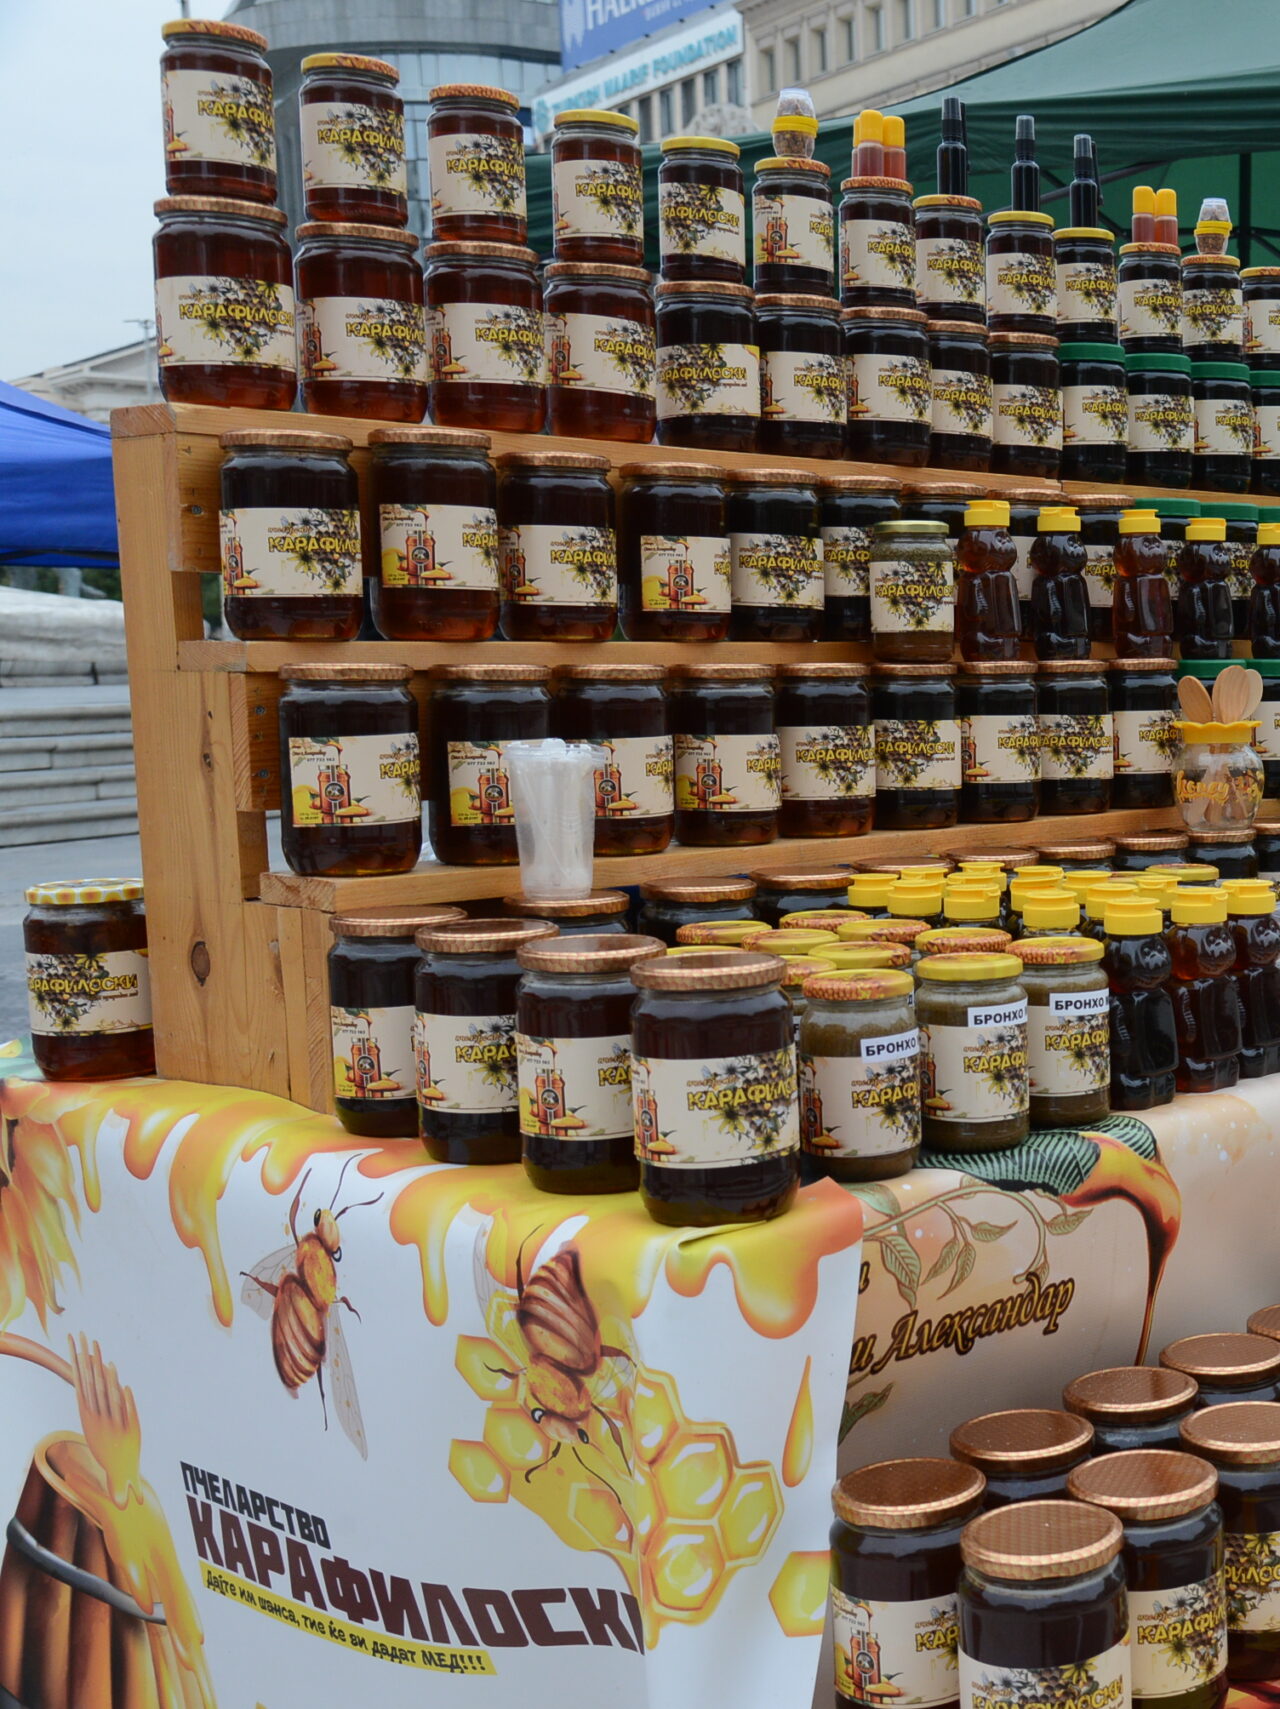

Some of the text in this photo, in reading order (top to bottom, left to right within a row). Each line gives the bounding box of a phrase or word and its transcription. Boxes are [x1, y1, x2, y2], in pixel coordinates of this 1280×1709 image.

[974, 1009, 1023, 1026] БРОНХО
[1054, 996, 1104, 1011] БРОНХО
[865, 1039, 918, 1056] БРОНХО
[869, 1271, 1075, 1375] Александар
[180, 1460, 331, 1550] ПЧЕЛАРСТВО
[207, 1569, 236, 1596] Дајте
[239, 1586, 257, 1606] им
[258, 1595, 301, 1627] шанса,
[301, 1613, 326, 1635] тие
[371, 1640, 417, 1664] дадат
[421, 1650, 486, 1674] МЕД!!!
